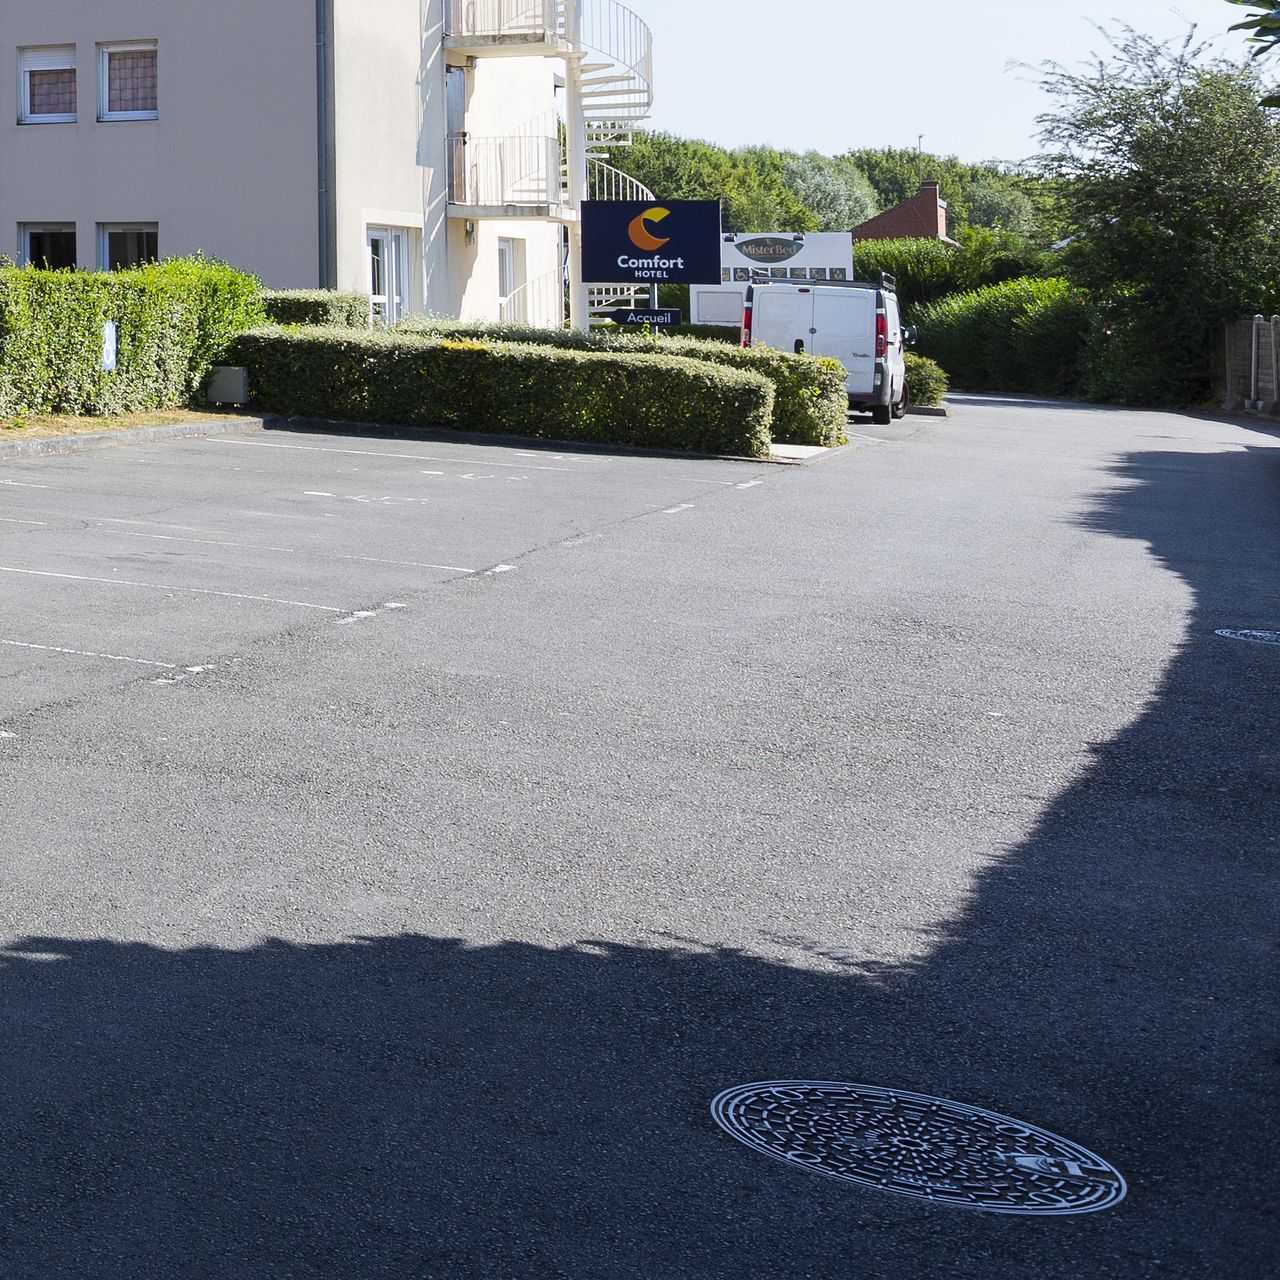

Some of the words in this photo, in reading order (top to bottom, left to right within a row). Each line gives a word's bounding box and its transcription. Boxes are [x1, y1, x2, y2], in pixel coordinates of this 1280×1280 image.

[742, 244, 774, 255] Mister
[775, 244, 796, 255] Bed
[617, 255, 684, 269] Comfort
[635, 270, 669, 278] HOTEL
[627, 312, 671, 323] Accueil
